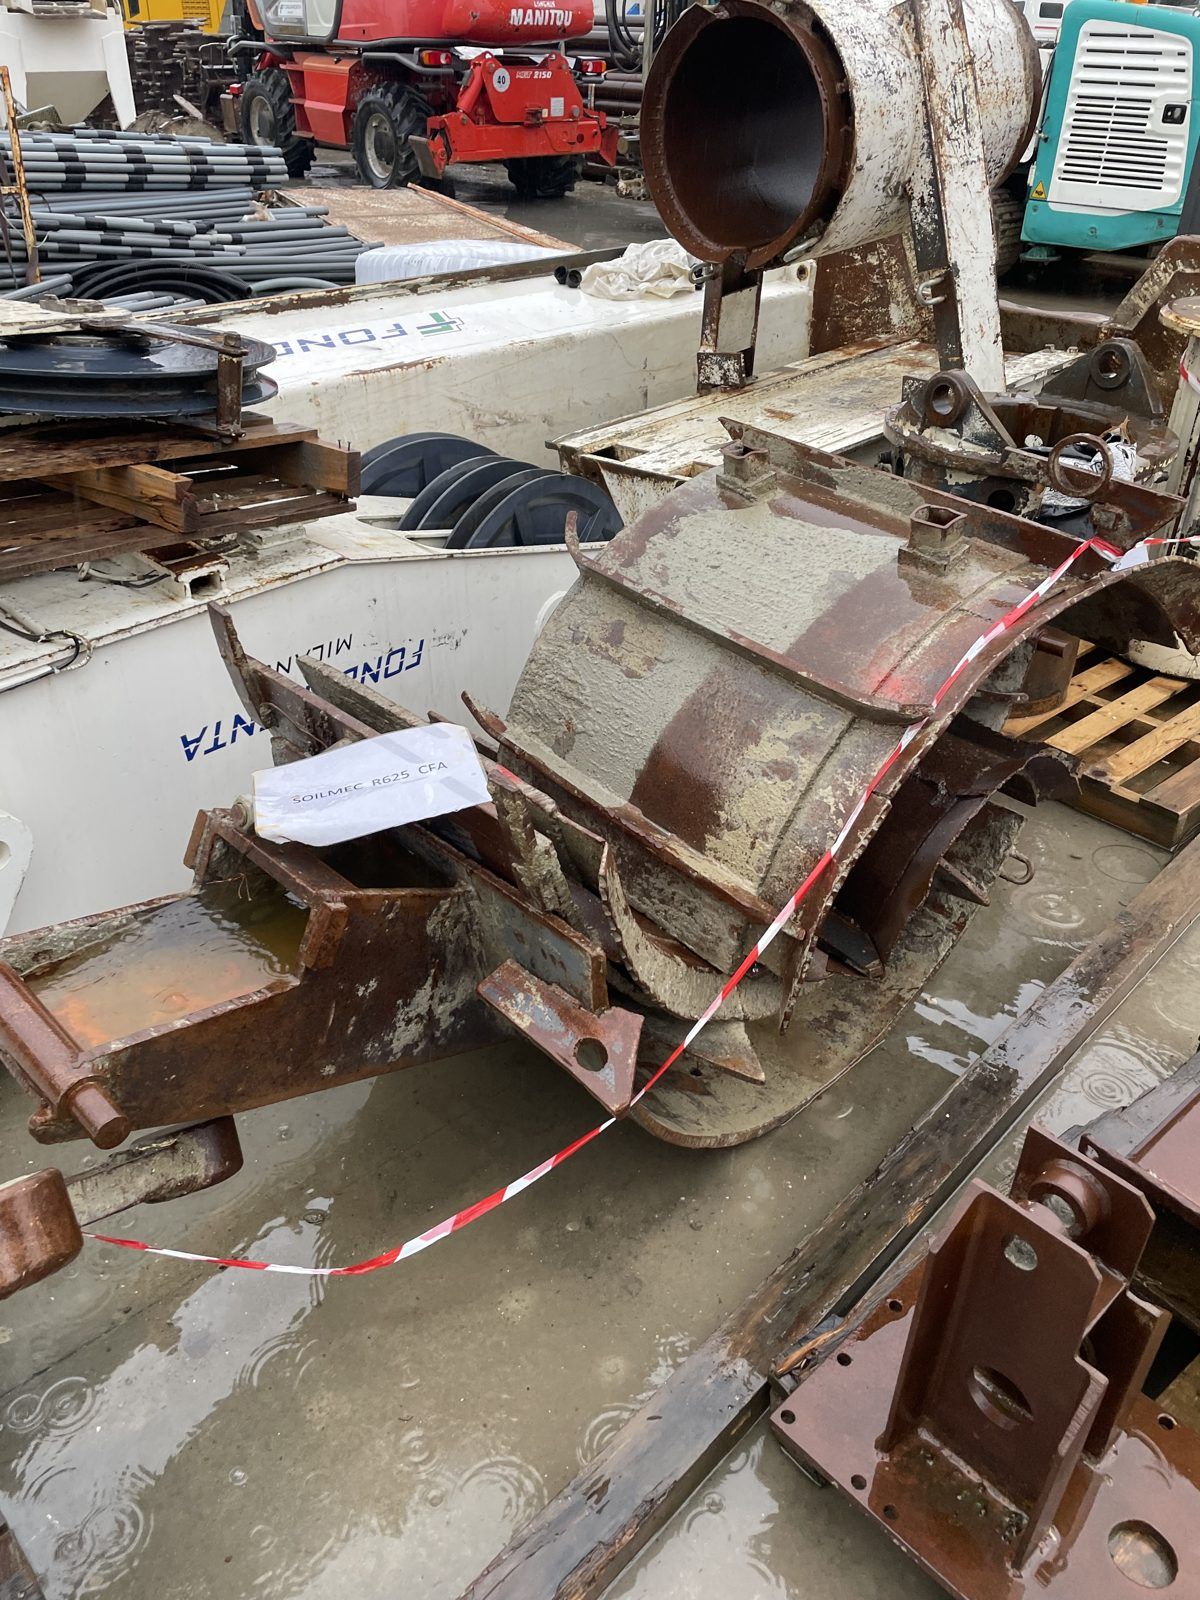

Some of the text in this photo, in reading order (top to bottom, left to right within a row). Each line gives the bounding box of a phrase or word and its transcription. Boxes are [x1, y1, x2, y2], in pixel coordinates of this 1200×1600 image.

[510, 8, 573, 27] MANITOU
[497, 75, 506, 85] 40
[533, 70, 552, 79] 2150
[267, 633, 353, 674] MILN
[292, 761, 448, 804] SOILMEC R625 CFA
